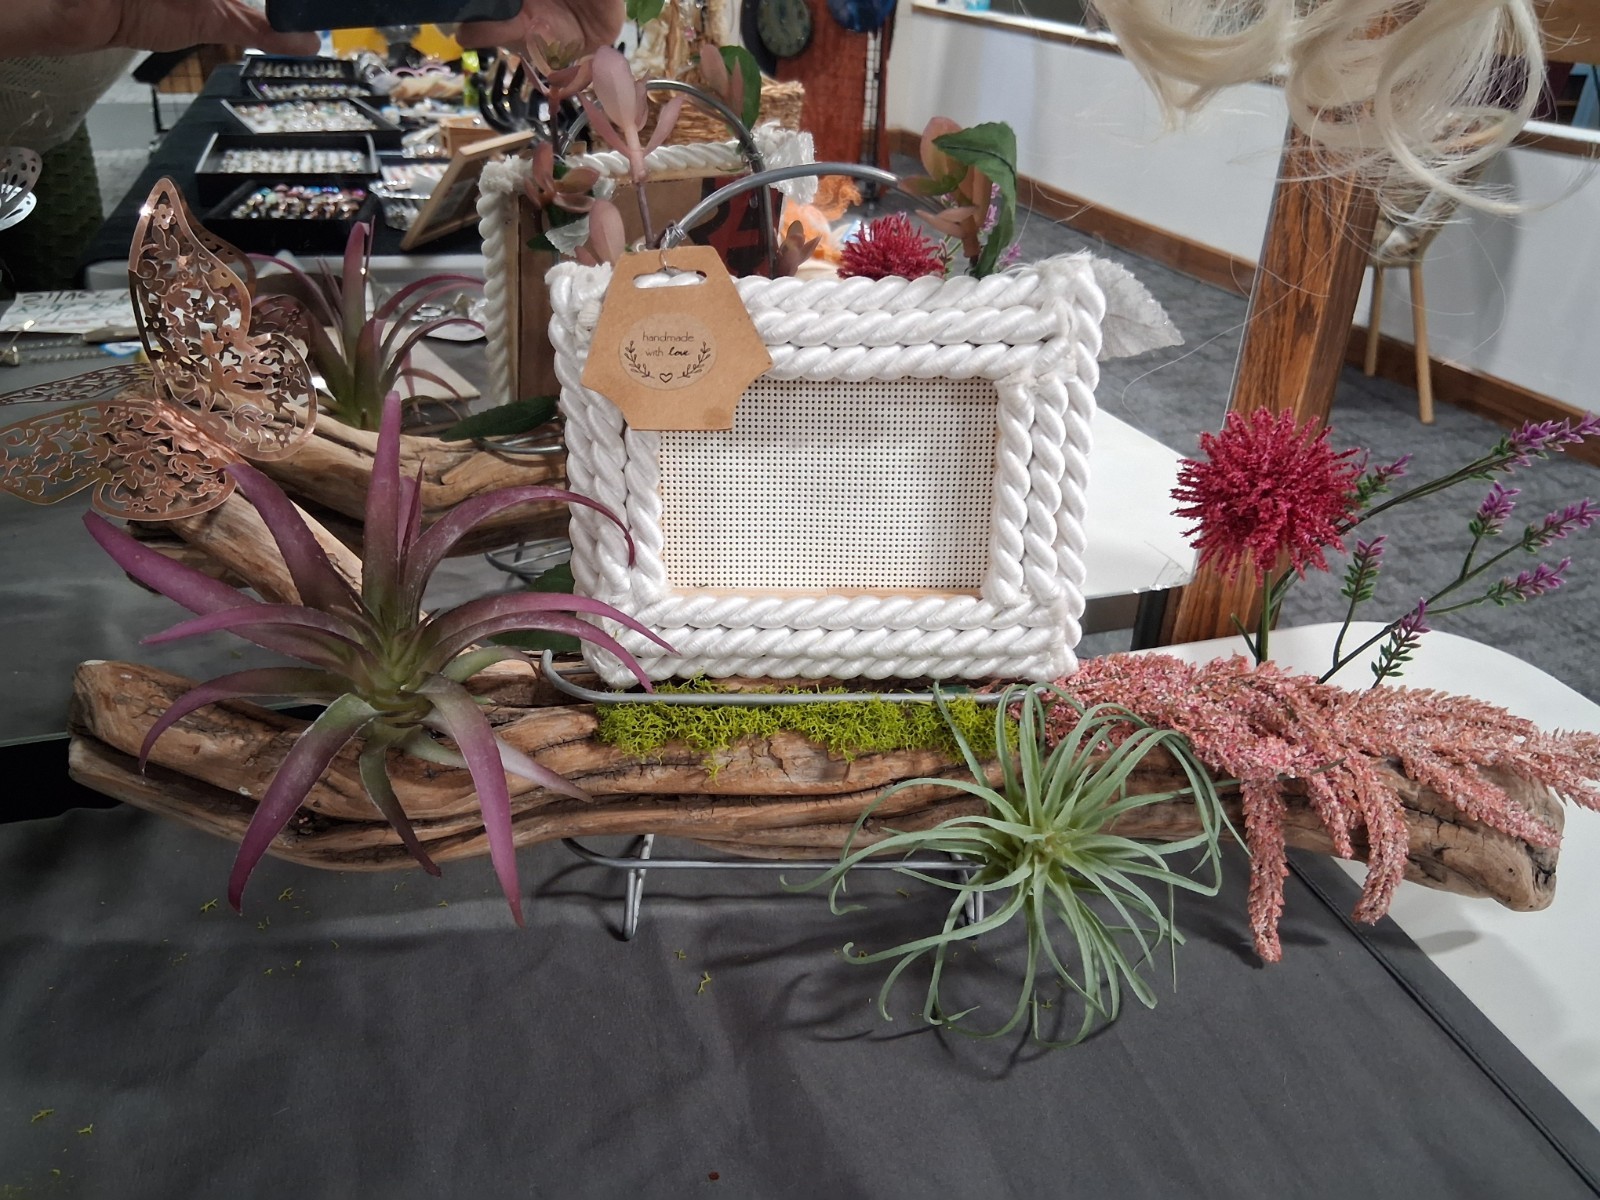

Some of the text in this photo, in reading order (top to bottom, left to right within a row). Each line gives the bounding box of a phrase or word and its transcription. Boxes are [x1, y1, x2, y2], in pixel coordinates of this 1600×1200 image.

[642, 331, 695, 342] handmade
[645, 346, 690, 357] with love
